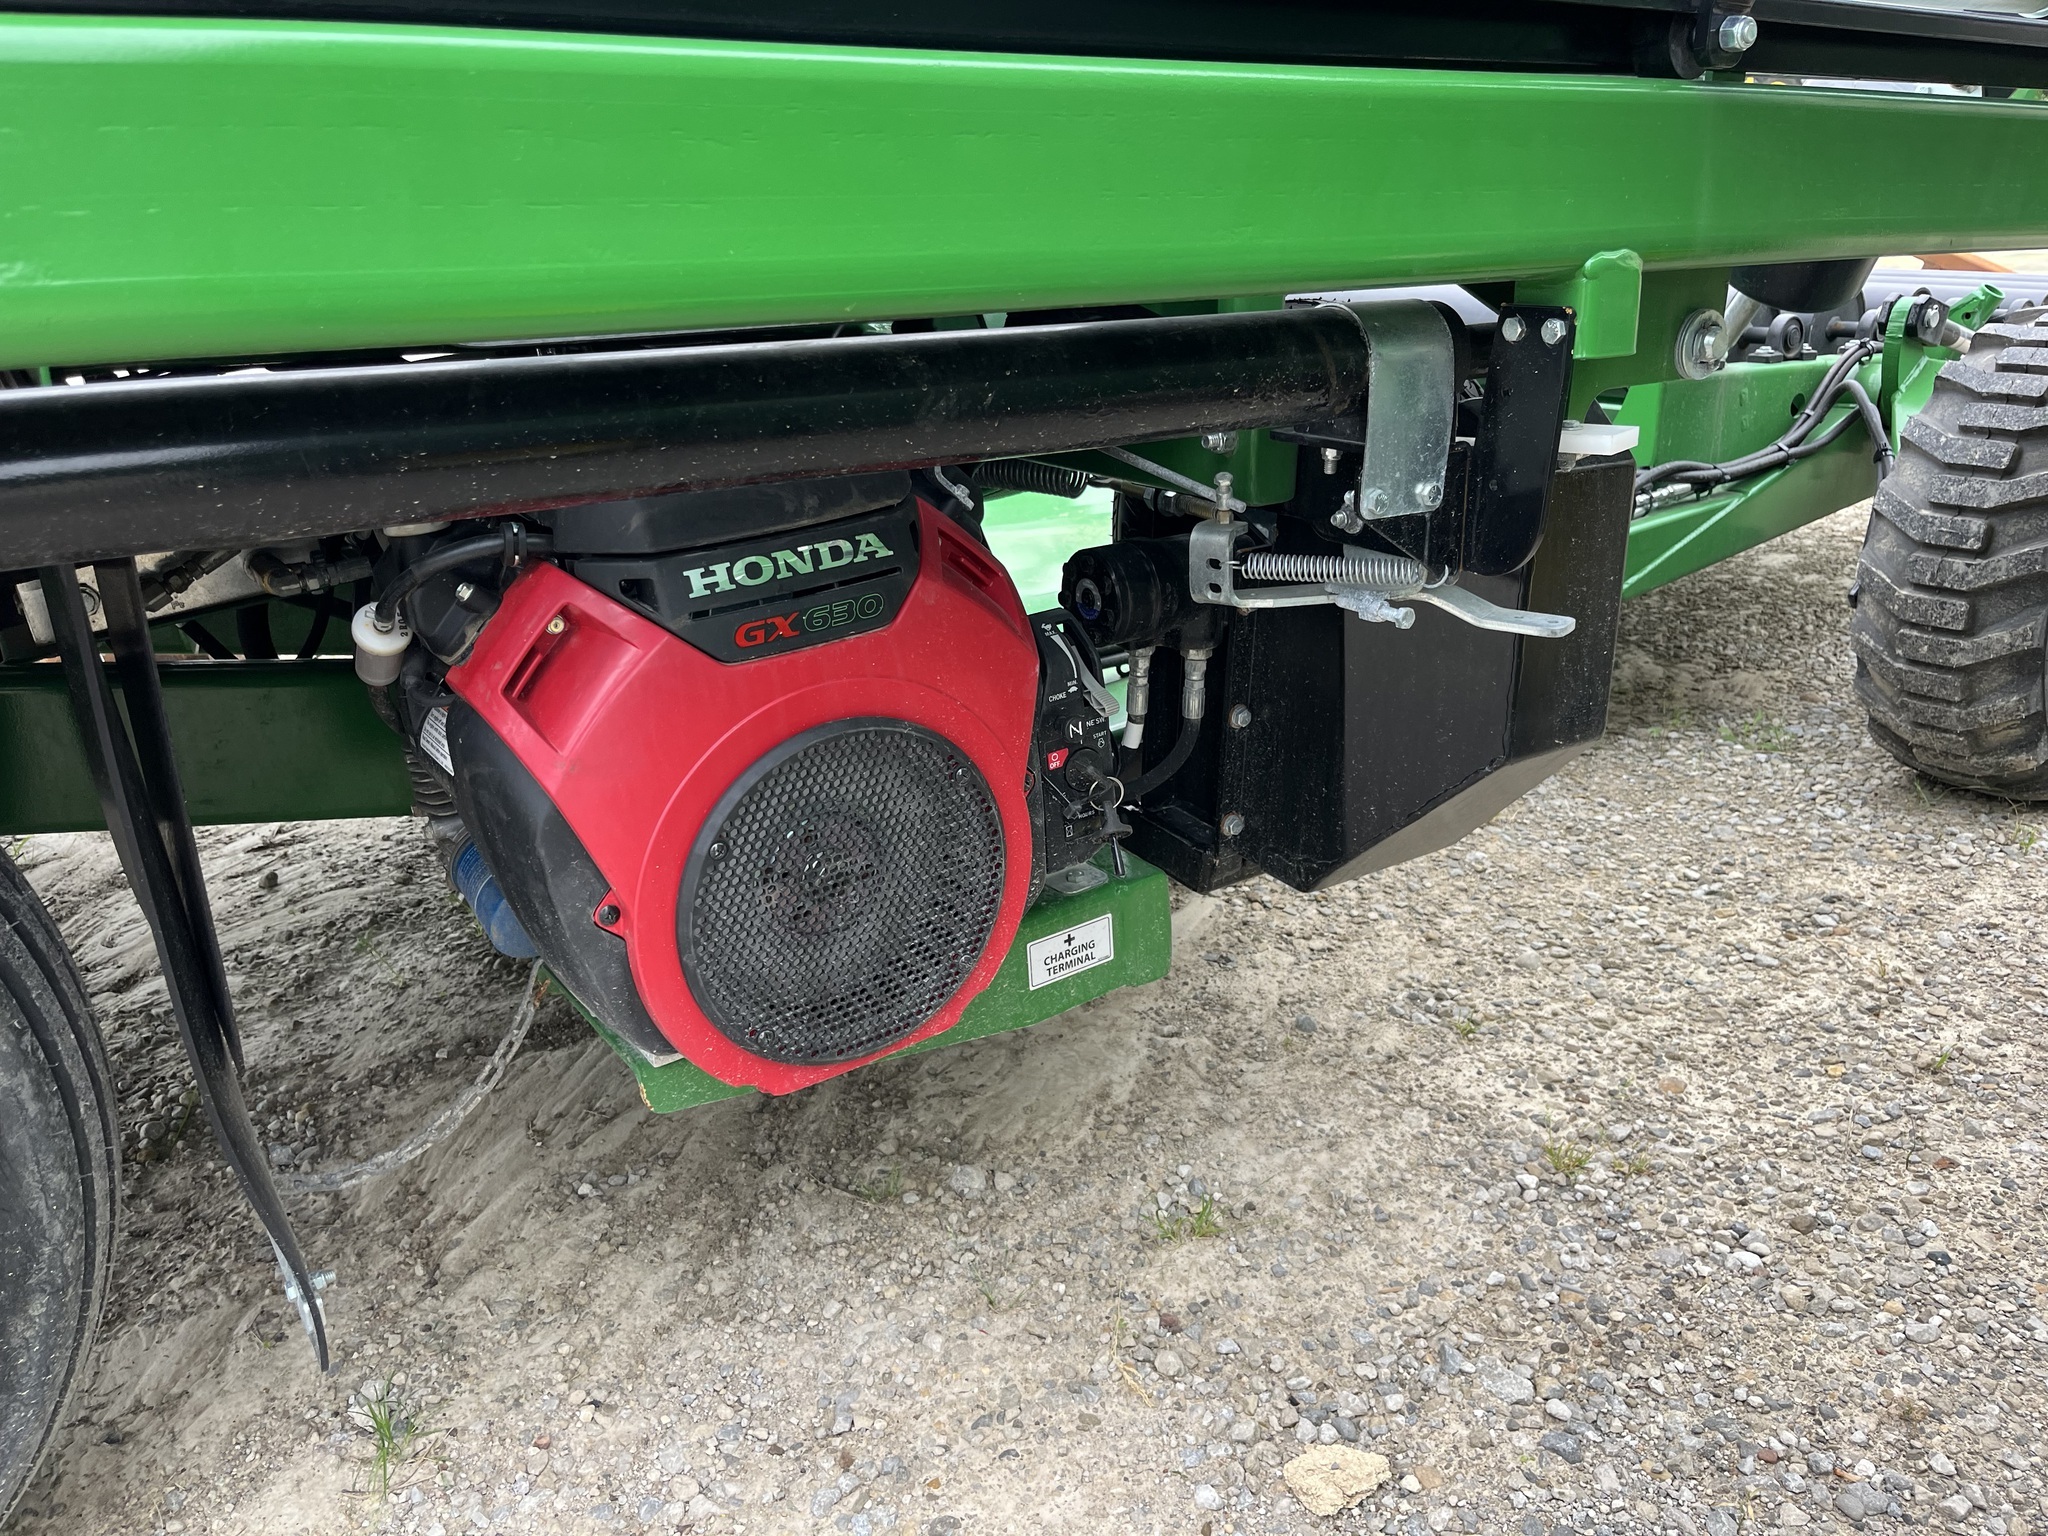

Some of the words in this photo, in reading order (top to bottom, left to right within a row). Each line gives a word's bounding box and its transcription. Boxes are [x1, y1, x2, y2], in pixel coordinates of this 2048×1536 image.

[683, 533, 894, 598] HONDA
[734, 611, 800, 648] GX
[804, 593, 884, 631] 630
[1049, 692, 1067, 702] CHOKE
[1093, 730, 1107, 739] START
[1049, 760, 1061, 769] OFF
[1044, 940, 1095, 966] CHARGING
[1047, 952, 1096, 976] TERMINAL
